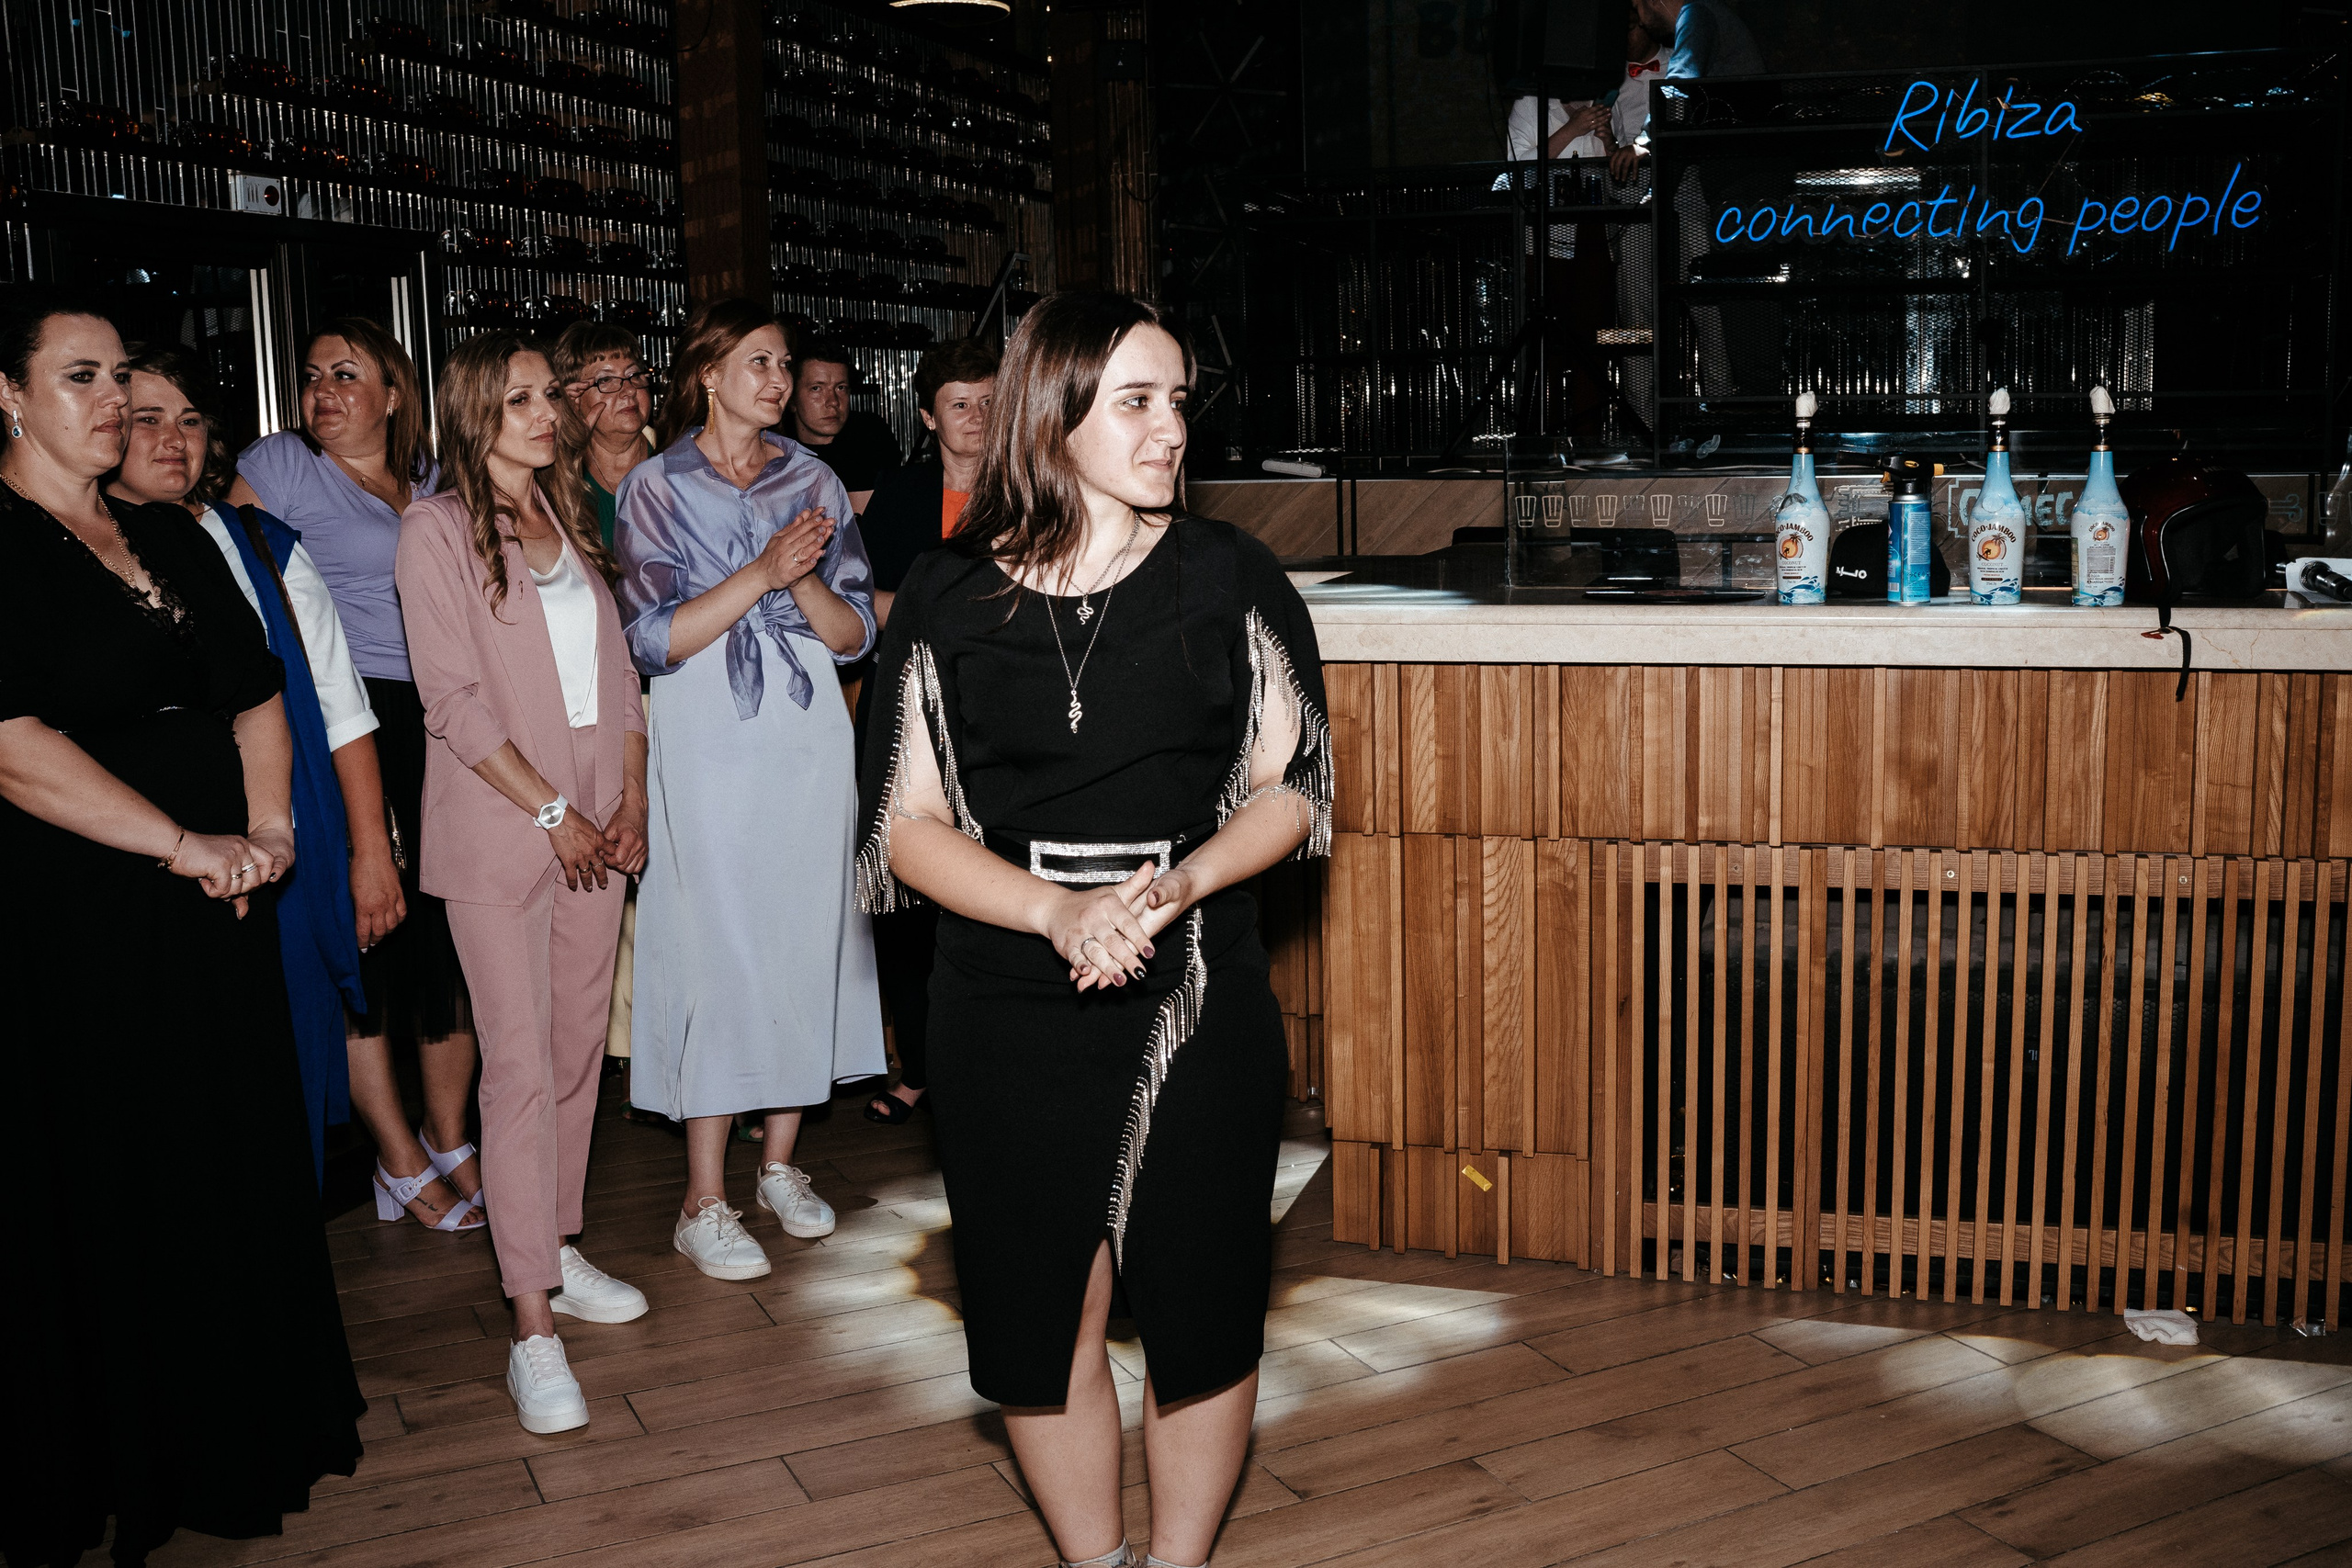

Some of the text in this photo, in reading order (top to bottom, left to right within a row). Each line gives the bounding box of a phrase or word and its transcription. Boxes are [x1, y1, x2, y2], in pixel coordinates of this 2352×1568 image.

[1883, 78, 2083, 152] Ribiza
[1715, 163, 2262, 255] connecting people
